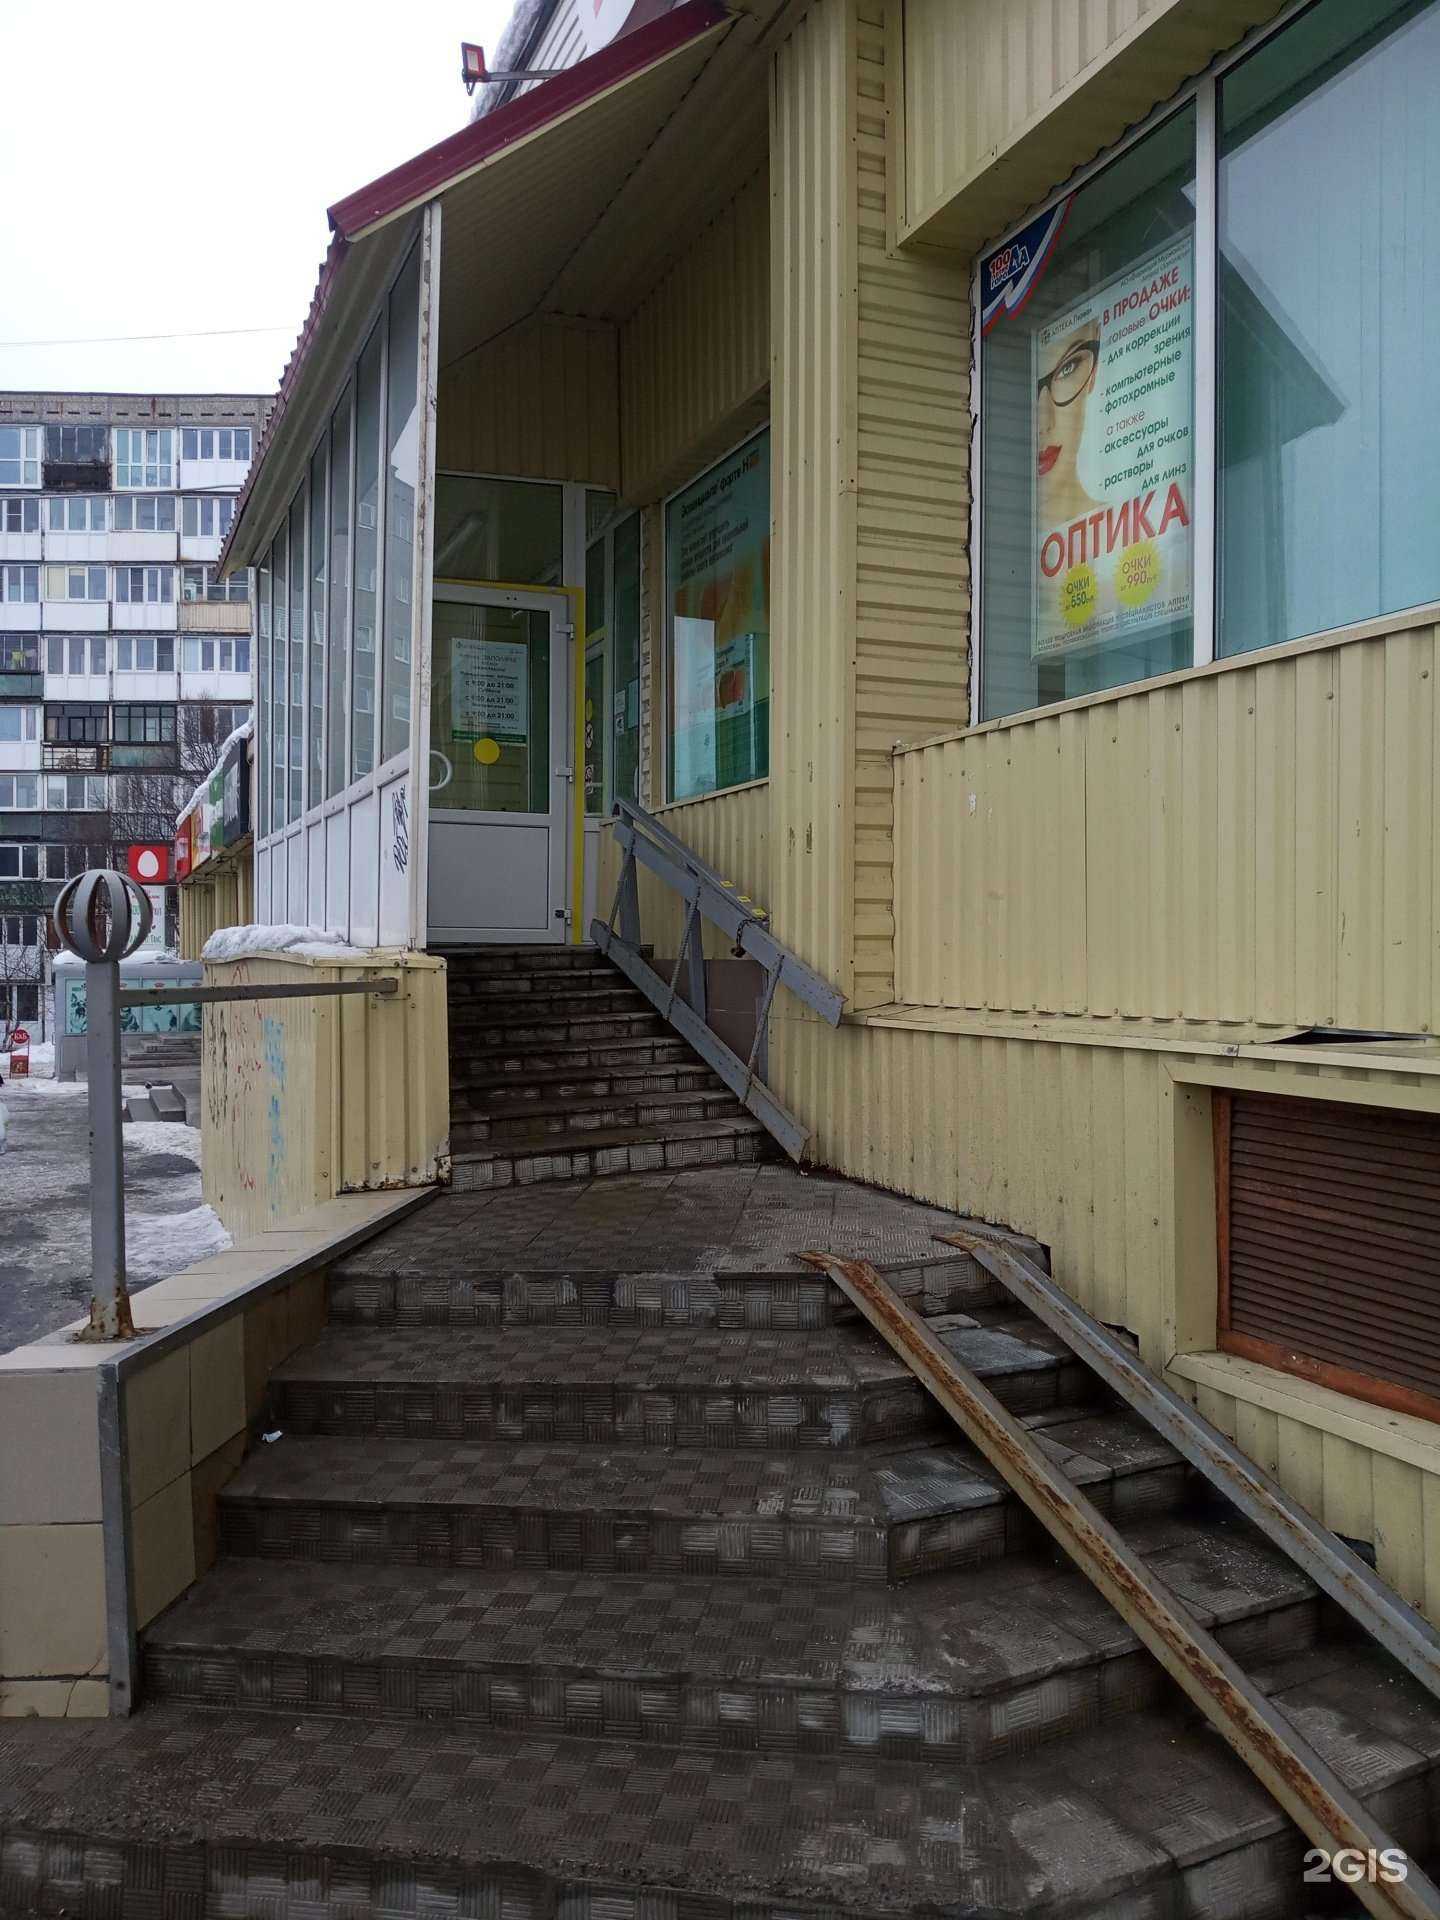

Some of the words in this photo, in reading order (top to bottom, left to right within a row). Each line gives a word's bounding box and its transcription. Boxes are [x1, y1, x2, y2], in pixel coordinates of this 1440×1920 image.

[1103, 309, 1110, 326] В
[1113, 266, 1179, 320] ПРОДАЖЕ
[1149, 284, 1191, 320] ОЧКИ:
[1107, 347, 1124, 366] для
[1125, 315, 1181, 354] коррекции
[1154, 326, 1192, 355] зрения
[1105, 350, 1183, 397] компьютерные
[1104, 371, 1176, 415] фотохромные
[1104, 416, 1169, 454] аксессуары
[1115, 408, 1146, 433] также
[1136, 441, 1155, 459] для
[1157, 426, 1190, 448] очков
[1104, 460, 1154, 491] растворы
[1141, 474, 1160, 492] для
[1162, 463, 1188, 482] линз
[1040, 482, 1190, 578] ОПТИКА
[1122, 552, 1151, 575] ОЧКИ
[1066, 576, 1090, 595] ОЧКИ
